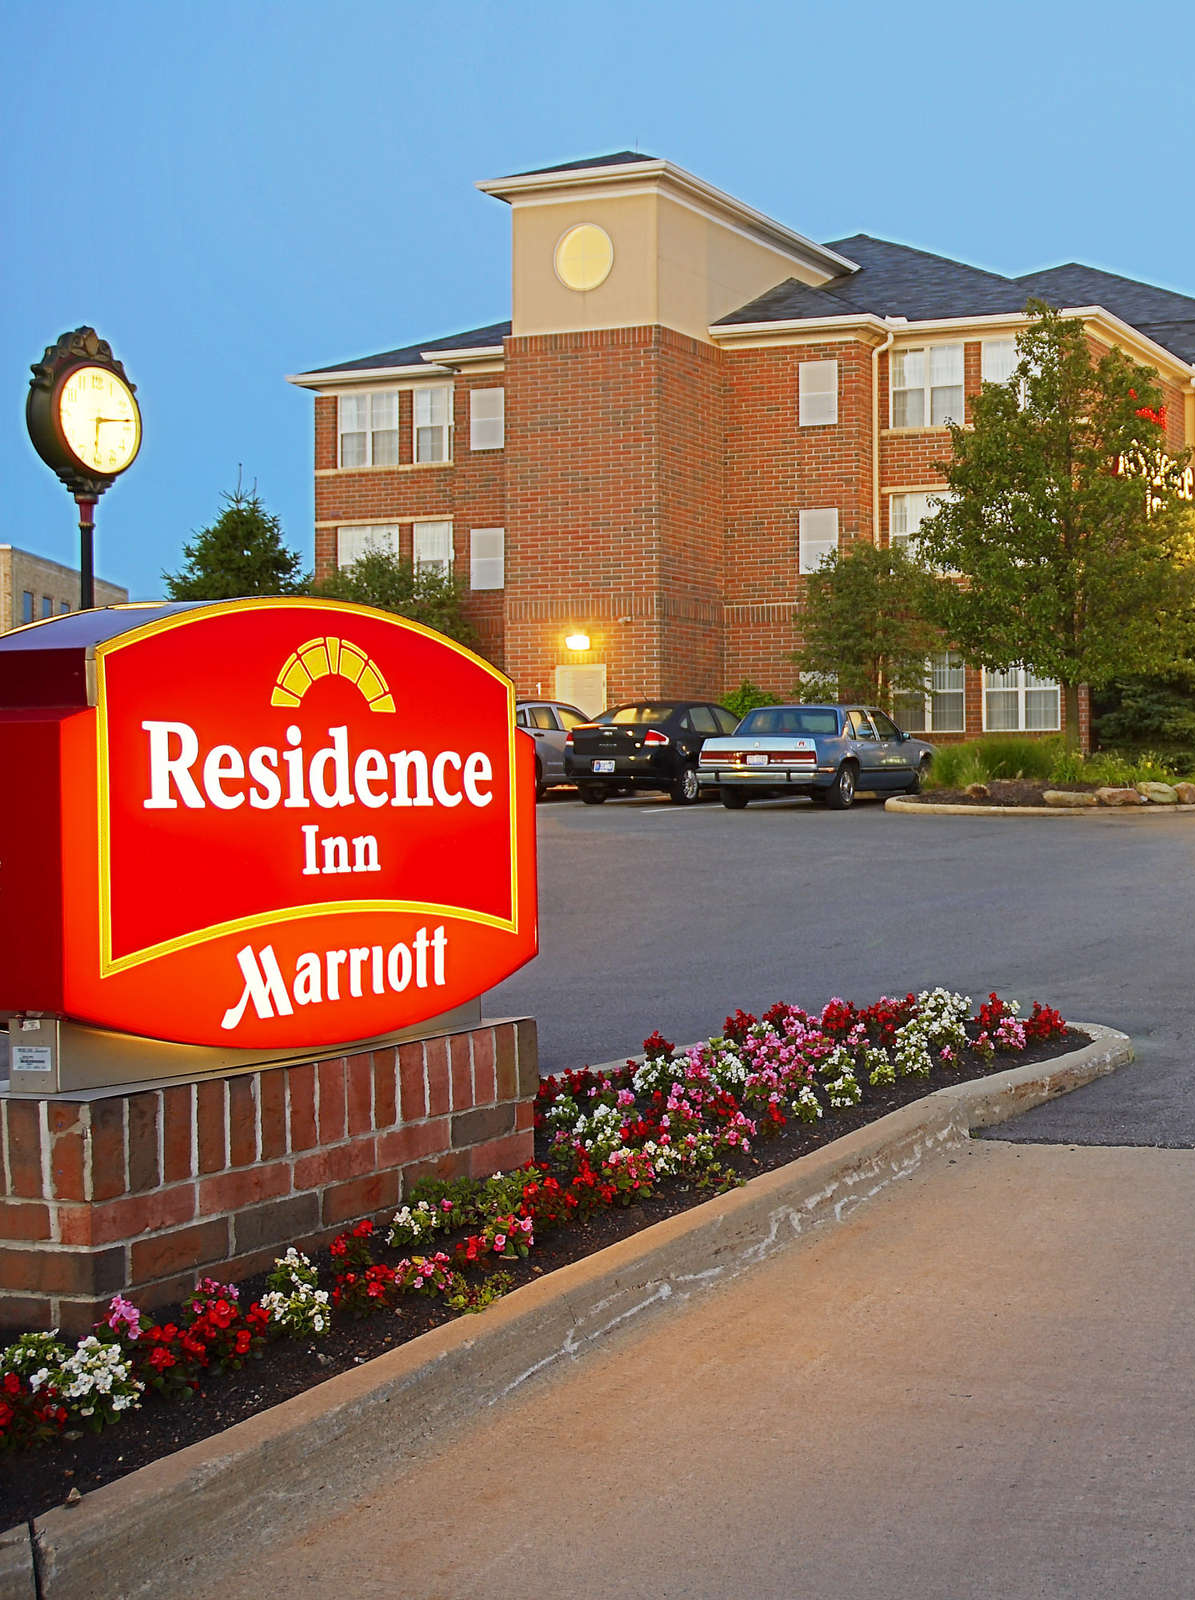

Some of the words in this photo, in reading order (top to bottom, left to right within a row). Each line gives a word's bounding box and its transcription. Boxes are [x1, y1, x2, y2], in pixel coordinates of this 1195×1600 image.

[142, 721, 493, 810] Residence
[301, 824, 382, 875] Inn
[221, 926, 448, 1030] Marriott
